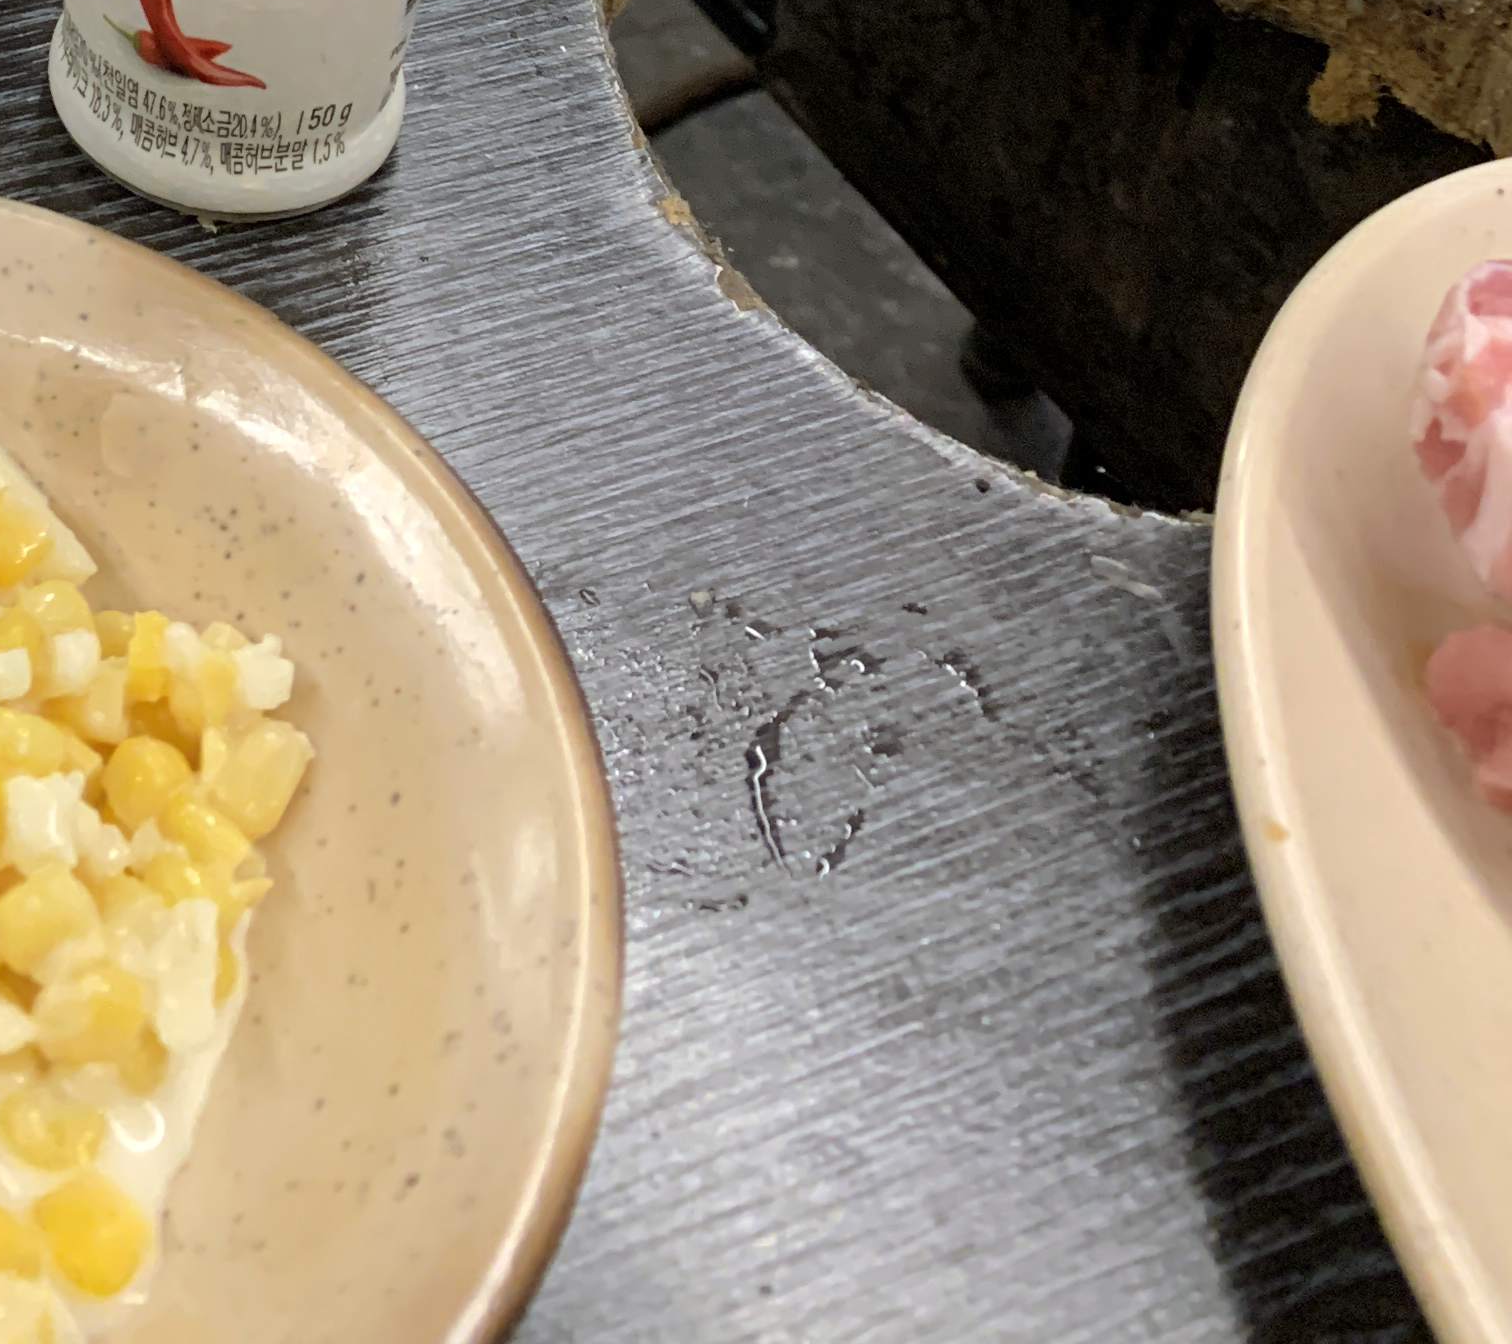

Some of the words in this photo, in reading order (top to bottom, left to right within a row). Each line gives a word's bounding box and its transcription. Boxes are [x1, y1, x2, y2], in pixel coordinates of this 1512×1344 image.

[130, 112, 178, 159] 매콤허브
[220, 136, 309, 176] 매콤허브분말
[313, 130, 346, 165] 1.5%
